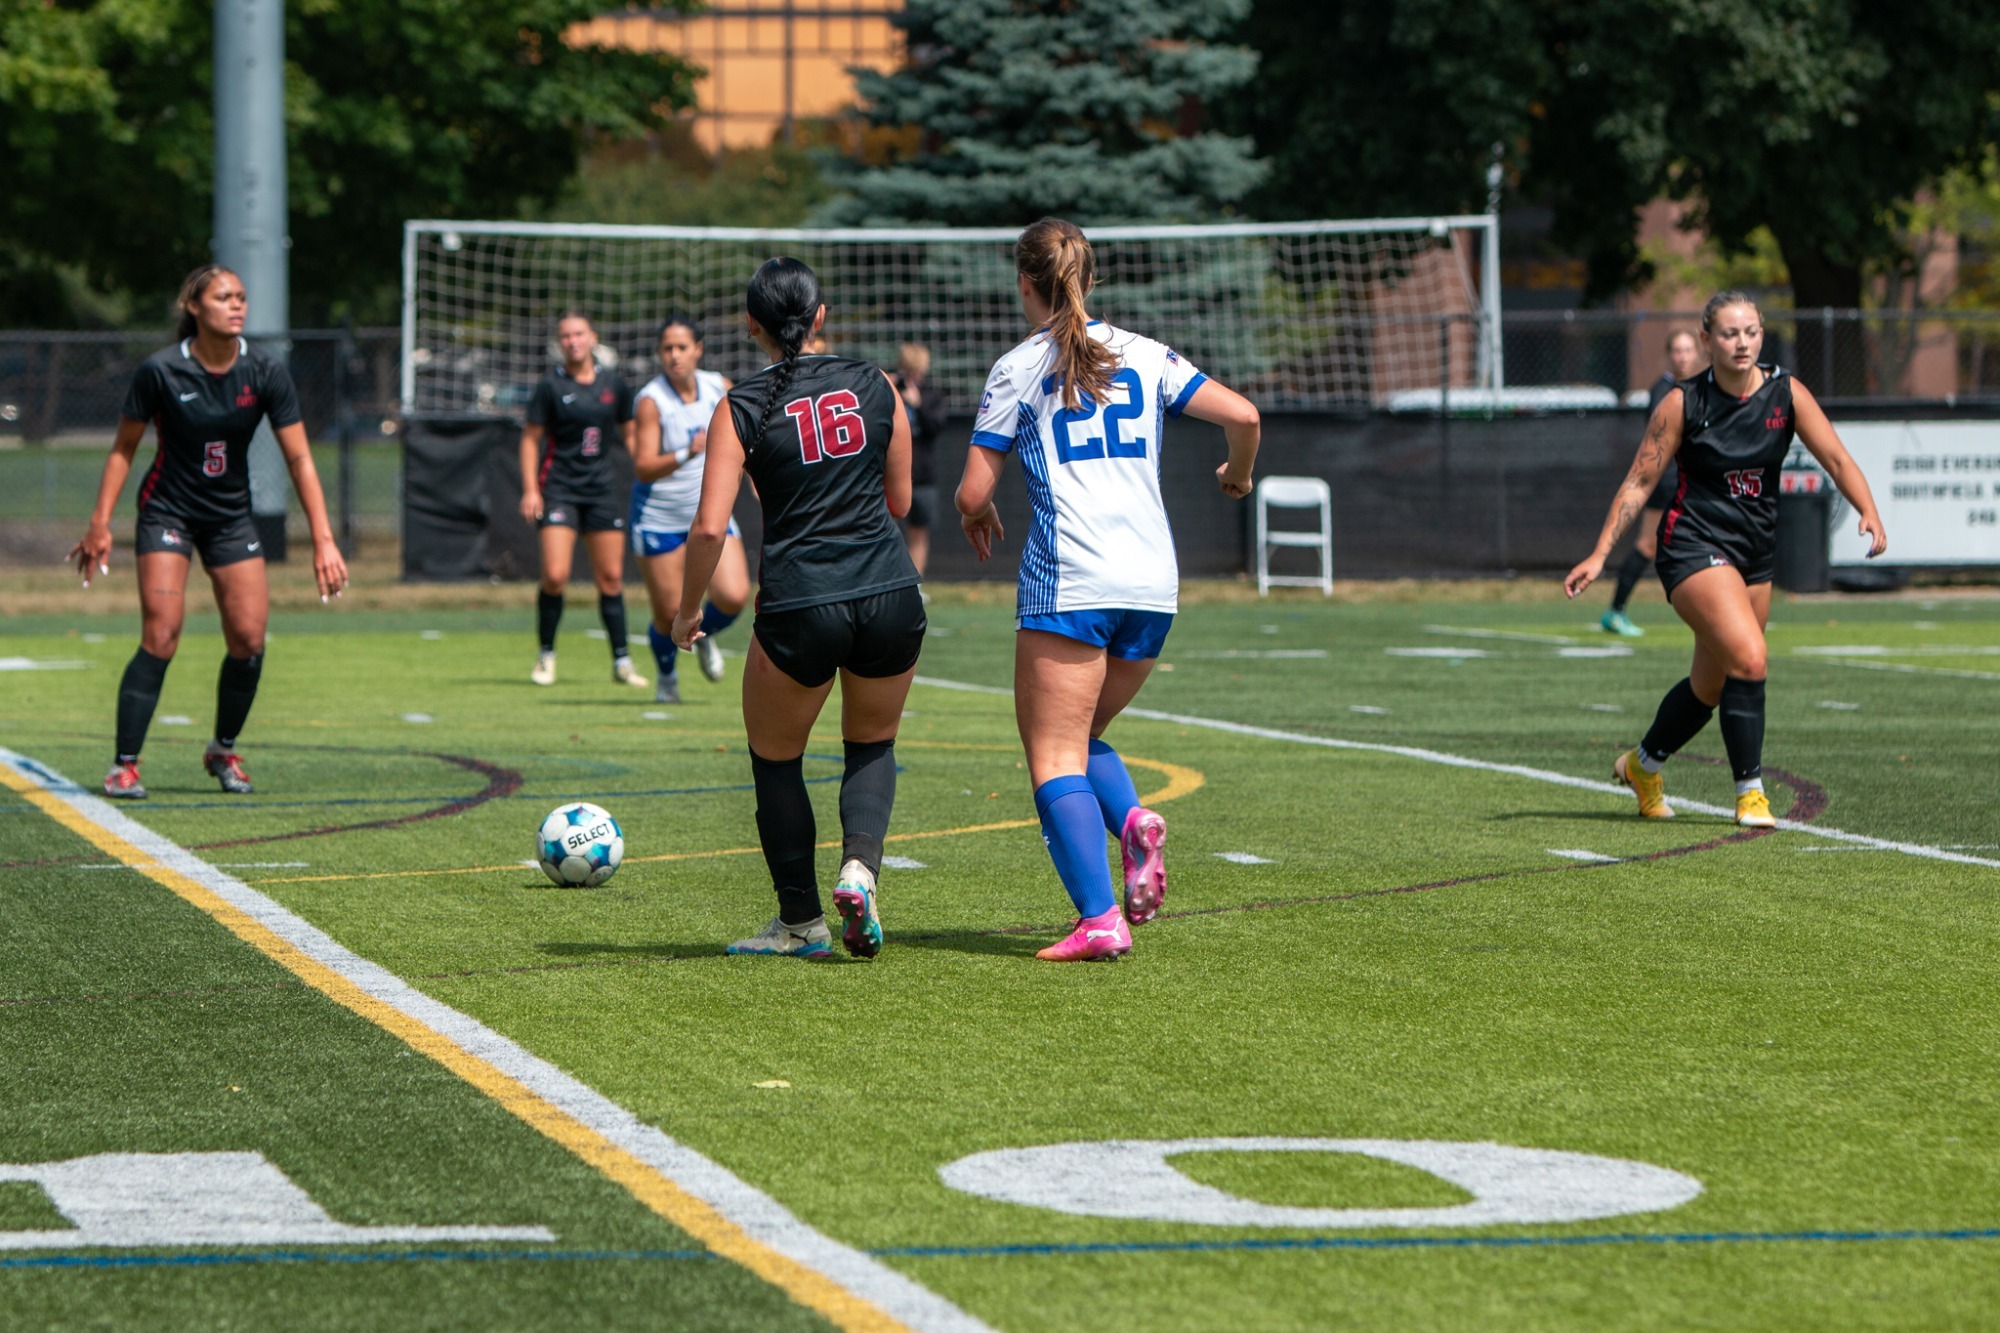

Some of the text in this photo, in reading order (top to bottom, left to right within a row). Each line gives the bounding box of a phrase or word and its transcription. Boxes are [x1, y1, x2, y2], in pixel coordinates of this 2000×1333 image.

[784, 388, 867, 465] 16
[1041, 367, 1147, 465] 22
[203, 440, 228, 478] 5
[1724, 468, 1765, 499] 15
[567, 823, 610, 849] SELECT
